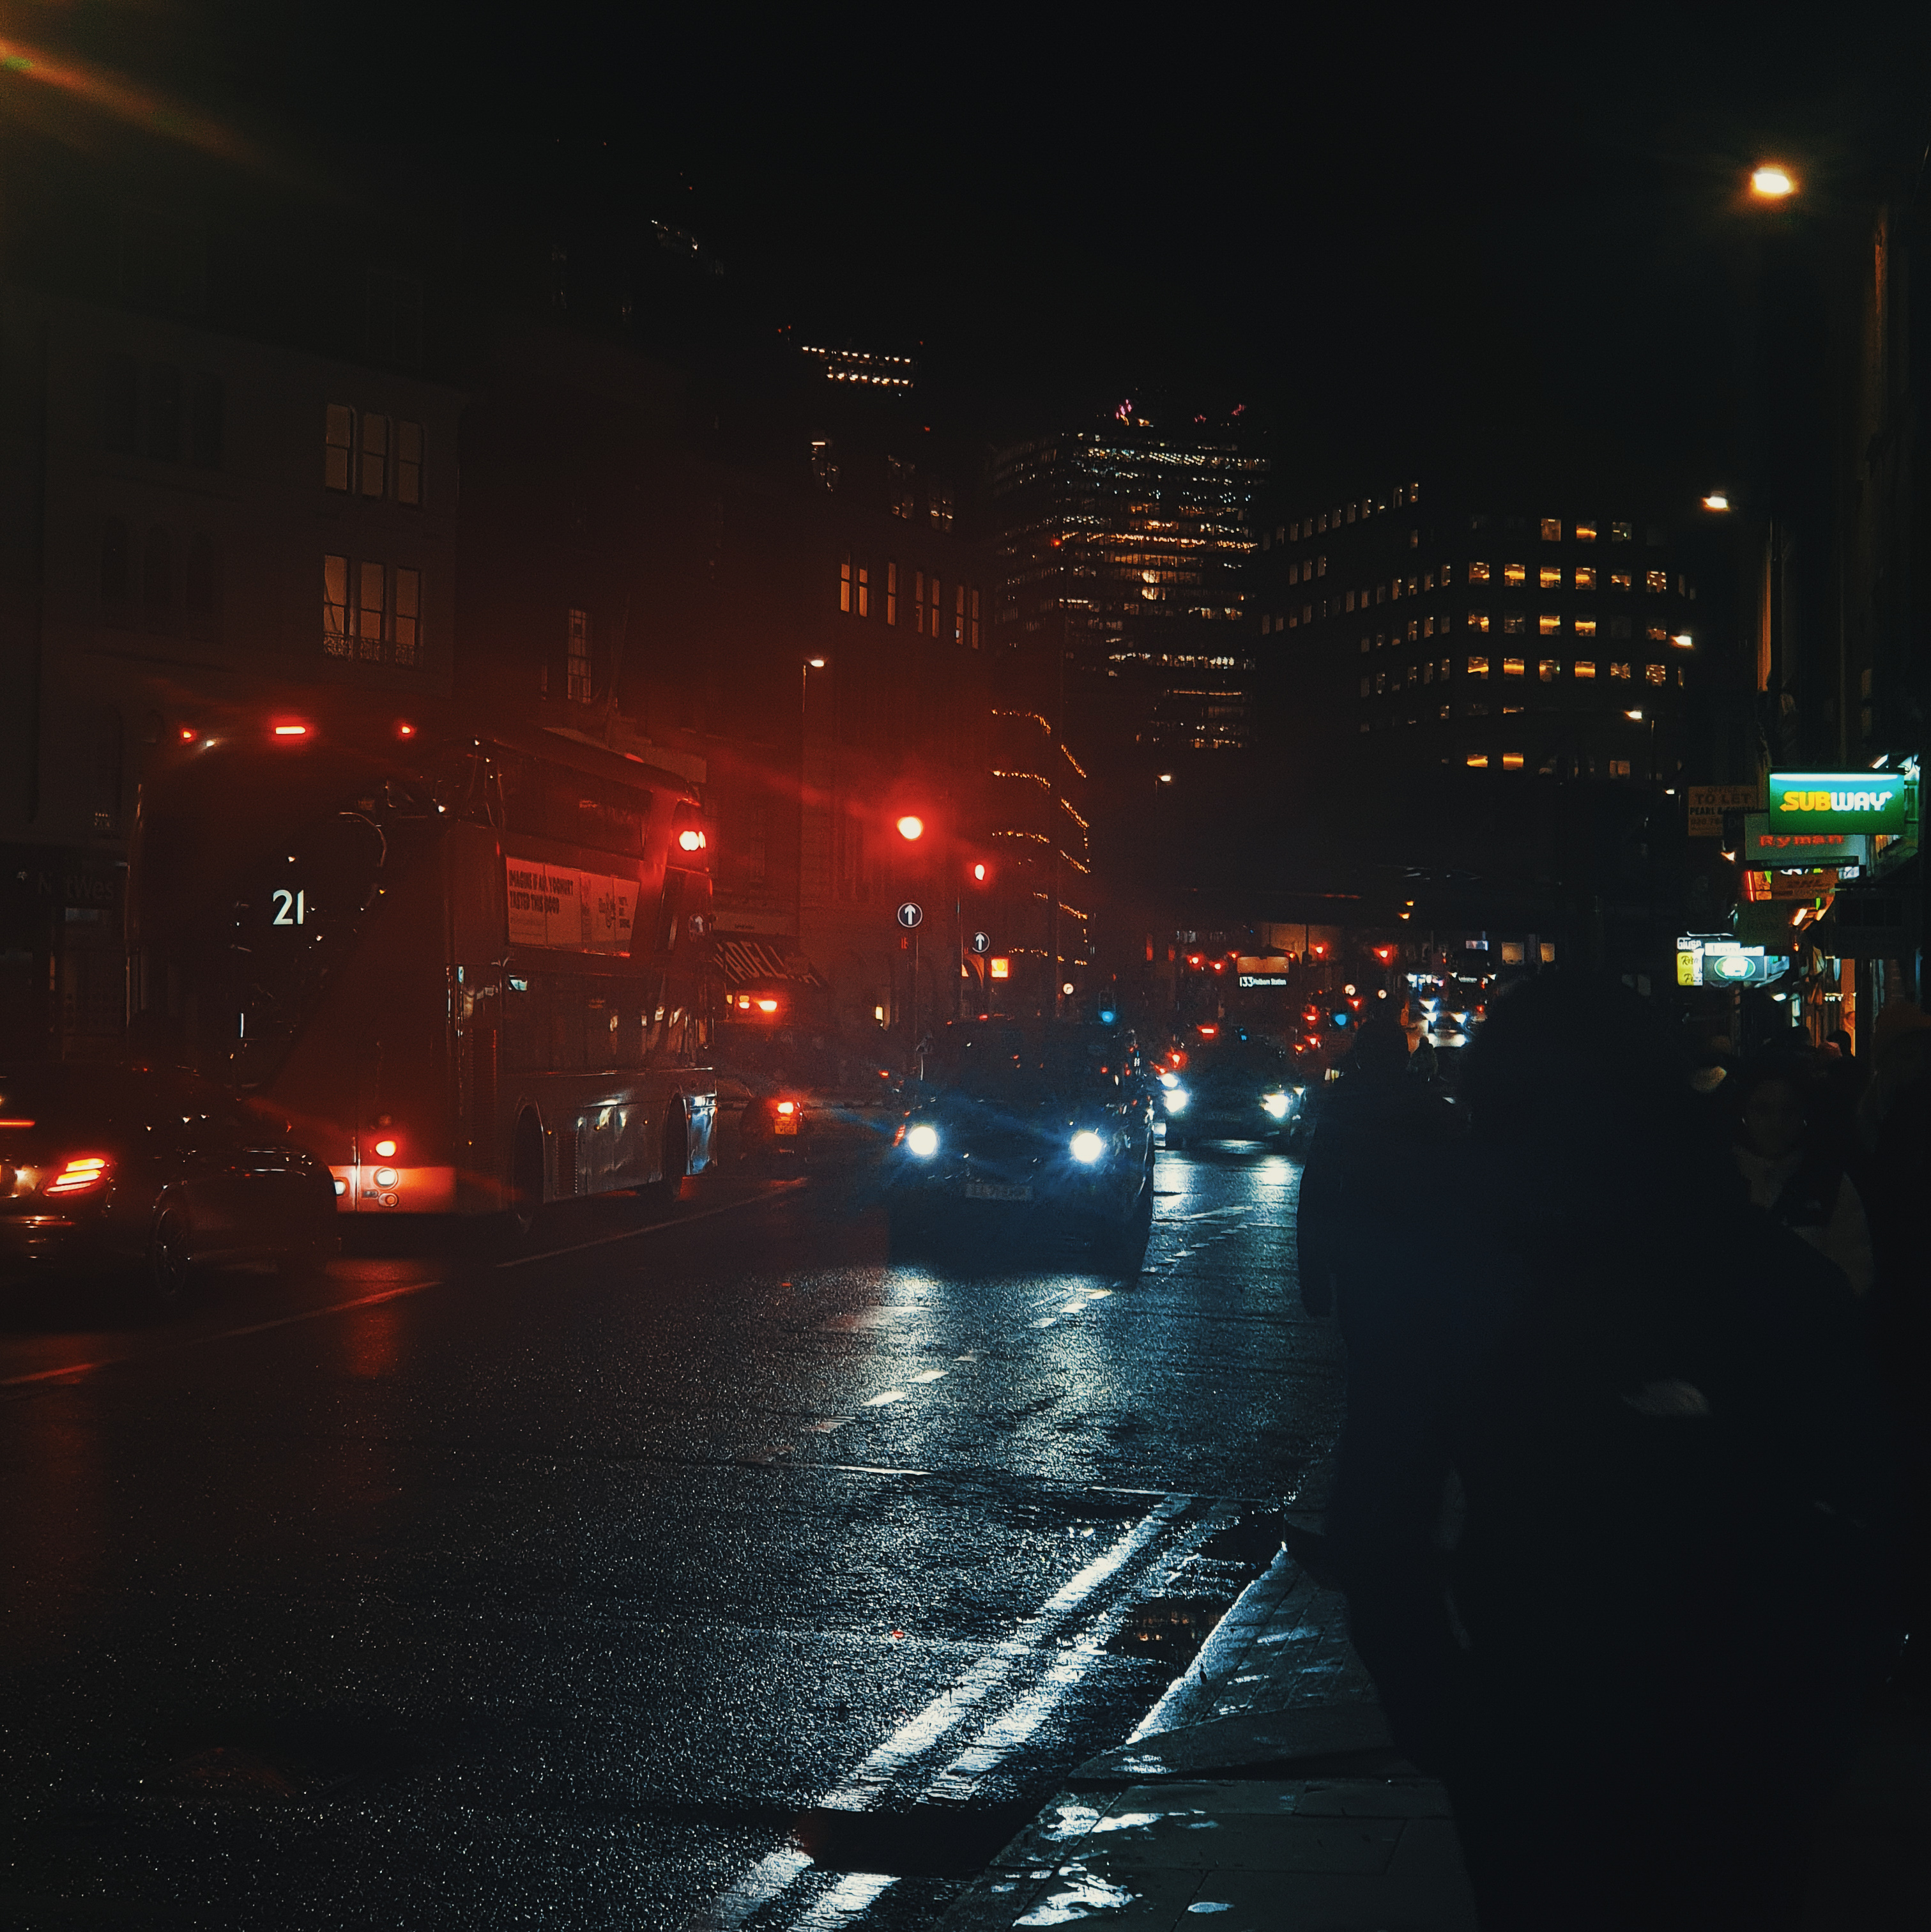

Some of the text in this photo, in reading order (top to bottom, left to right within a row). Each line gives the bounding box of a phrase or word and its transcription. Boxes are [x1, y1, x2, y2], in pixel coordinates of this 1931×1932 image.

[1695, 793, 1751, 804] TO LET
[1780, 792, 1893, 812] SUBWAY
[1759, 834, 1843, 848] Ryman
[509, 870, 531, 889] IMAGINE
[548, 877, 574, 895] YOGHURT
[273, 889, 304, 925] 21
[510, 891, 529, 910] TASTED
[1239, 976, 1253, 987] 133
